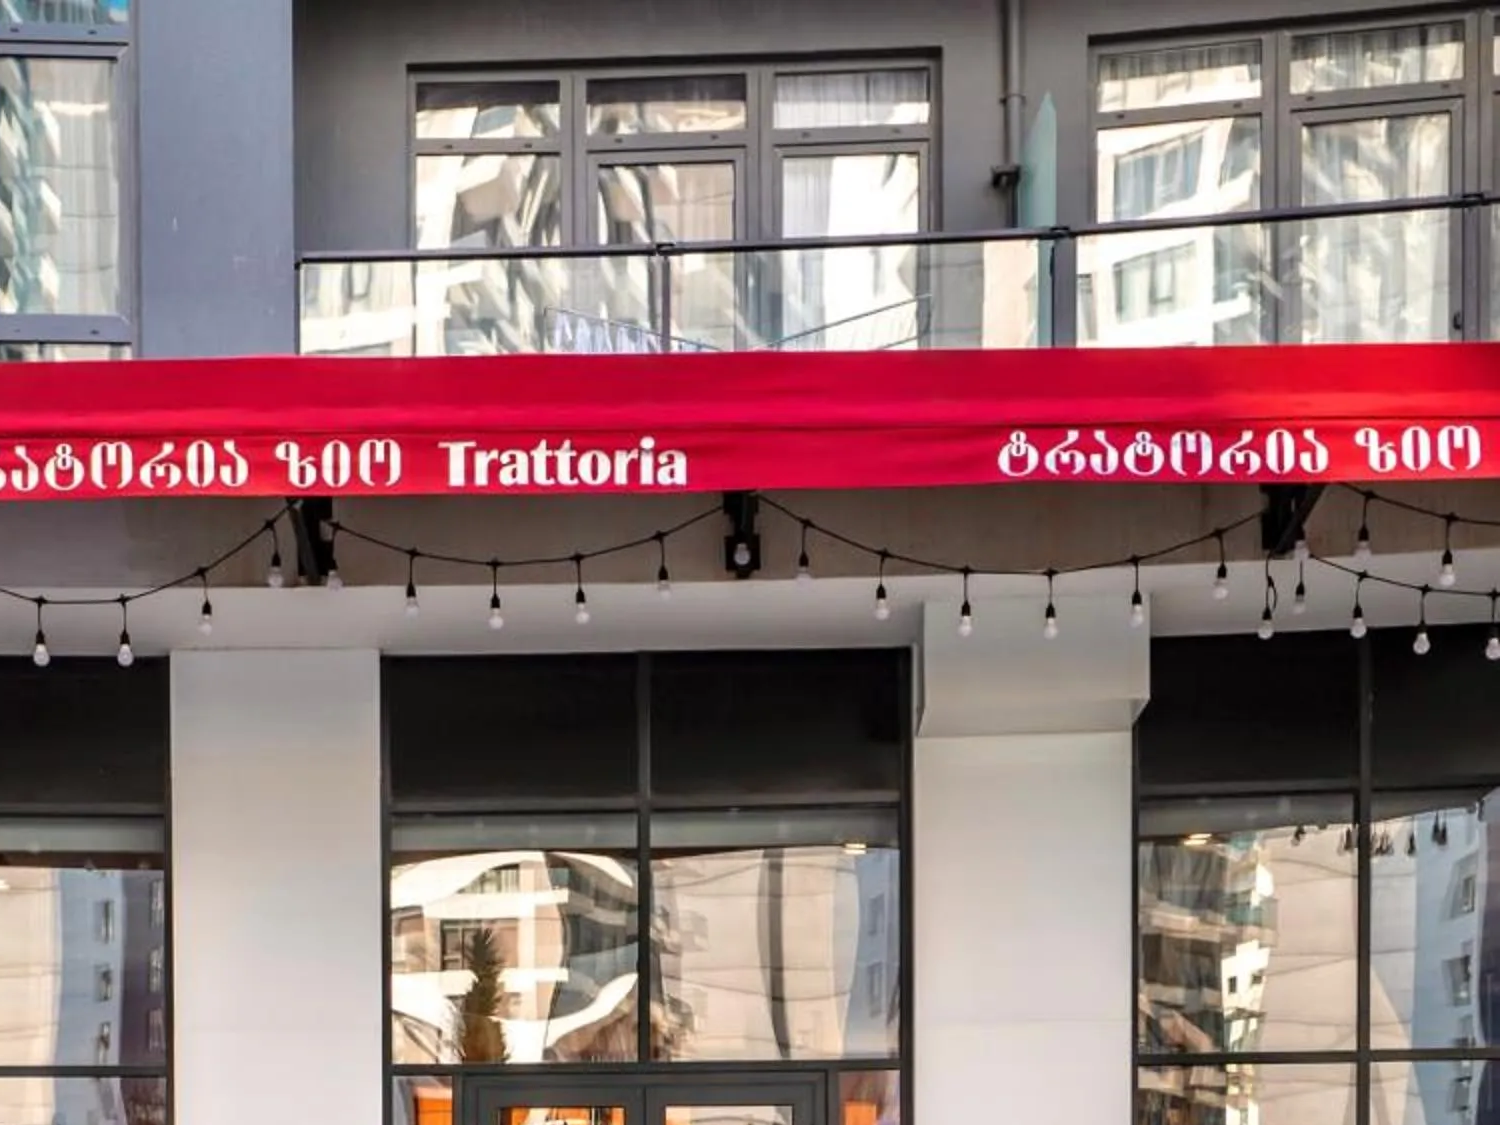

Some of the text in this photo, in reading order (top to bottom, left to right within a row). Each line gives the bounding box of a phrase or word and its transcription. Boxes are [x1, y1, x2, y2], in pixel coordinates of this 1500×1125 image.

[274, 439, 401, 488] ზიო
[439, 436, 687, 487] Trattoria
[997, 425, 1481, 477] ტრატორია ზიო
